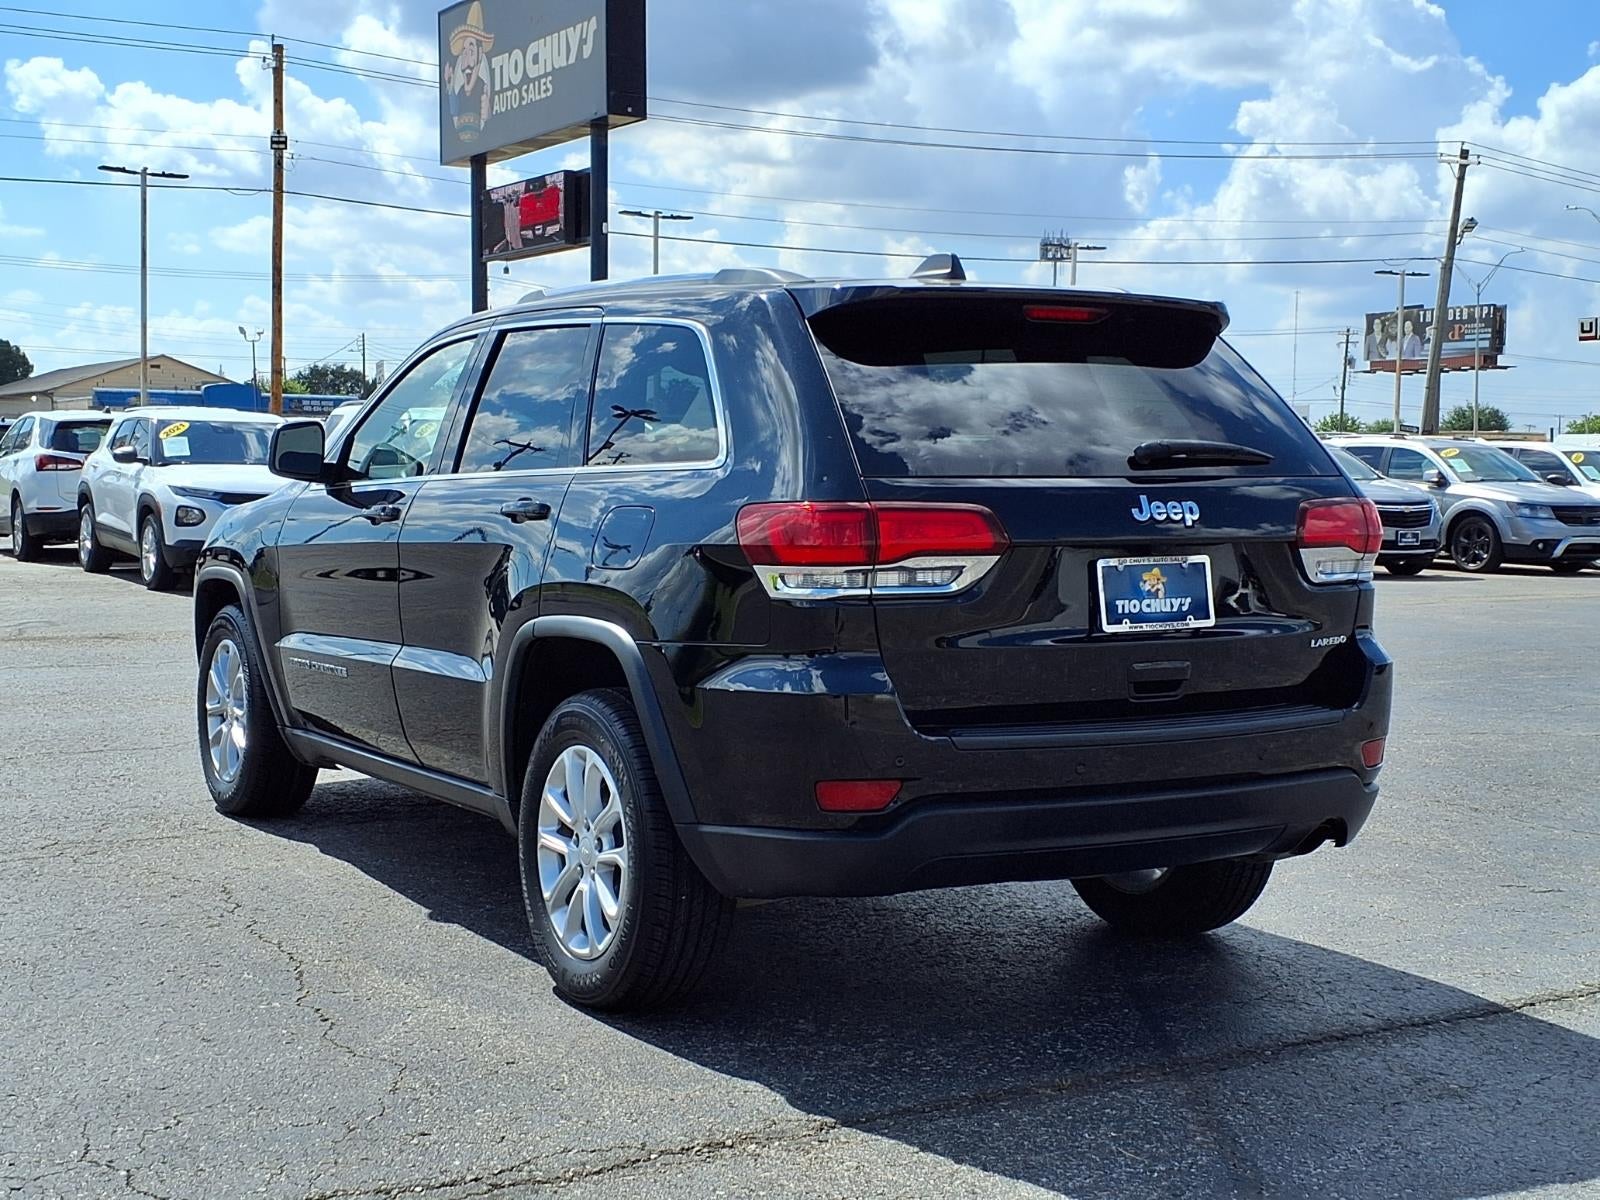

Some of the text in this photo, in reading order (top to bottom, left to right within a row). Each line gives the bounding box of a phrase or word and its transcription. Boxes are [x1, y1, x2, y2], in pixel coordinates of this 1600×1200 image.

[492, 16, 597, 91] TIO CHUY'S
[493, 76, 552, 115] AUTO SALES
[1419, 308, 1468, 322] THDER
[1131, 495, 1200, 526] Jeep
[1116, 597, 1192, 614] TIO CHUY'S
[1128, 622, 1190, 630] WWW.TIOCHUYS.COM
[1310, 635, 1347, 648] LAREDO
